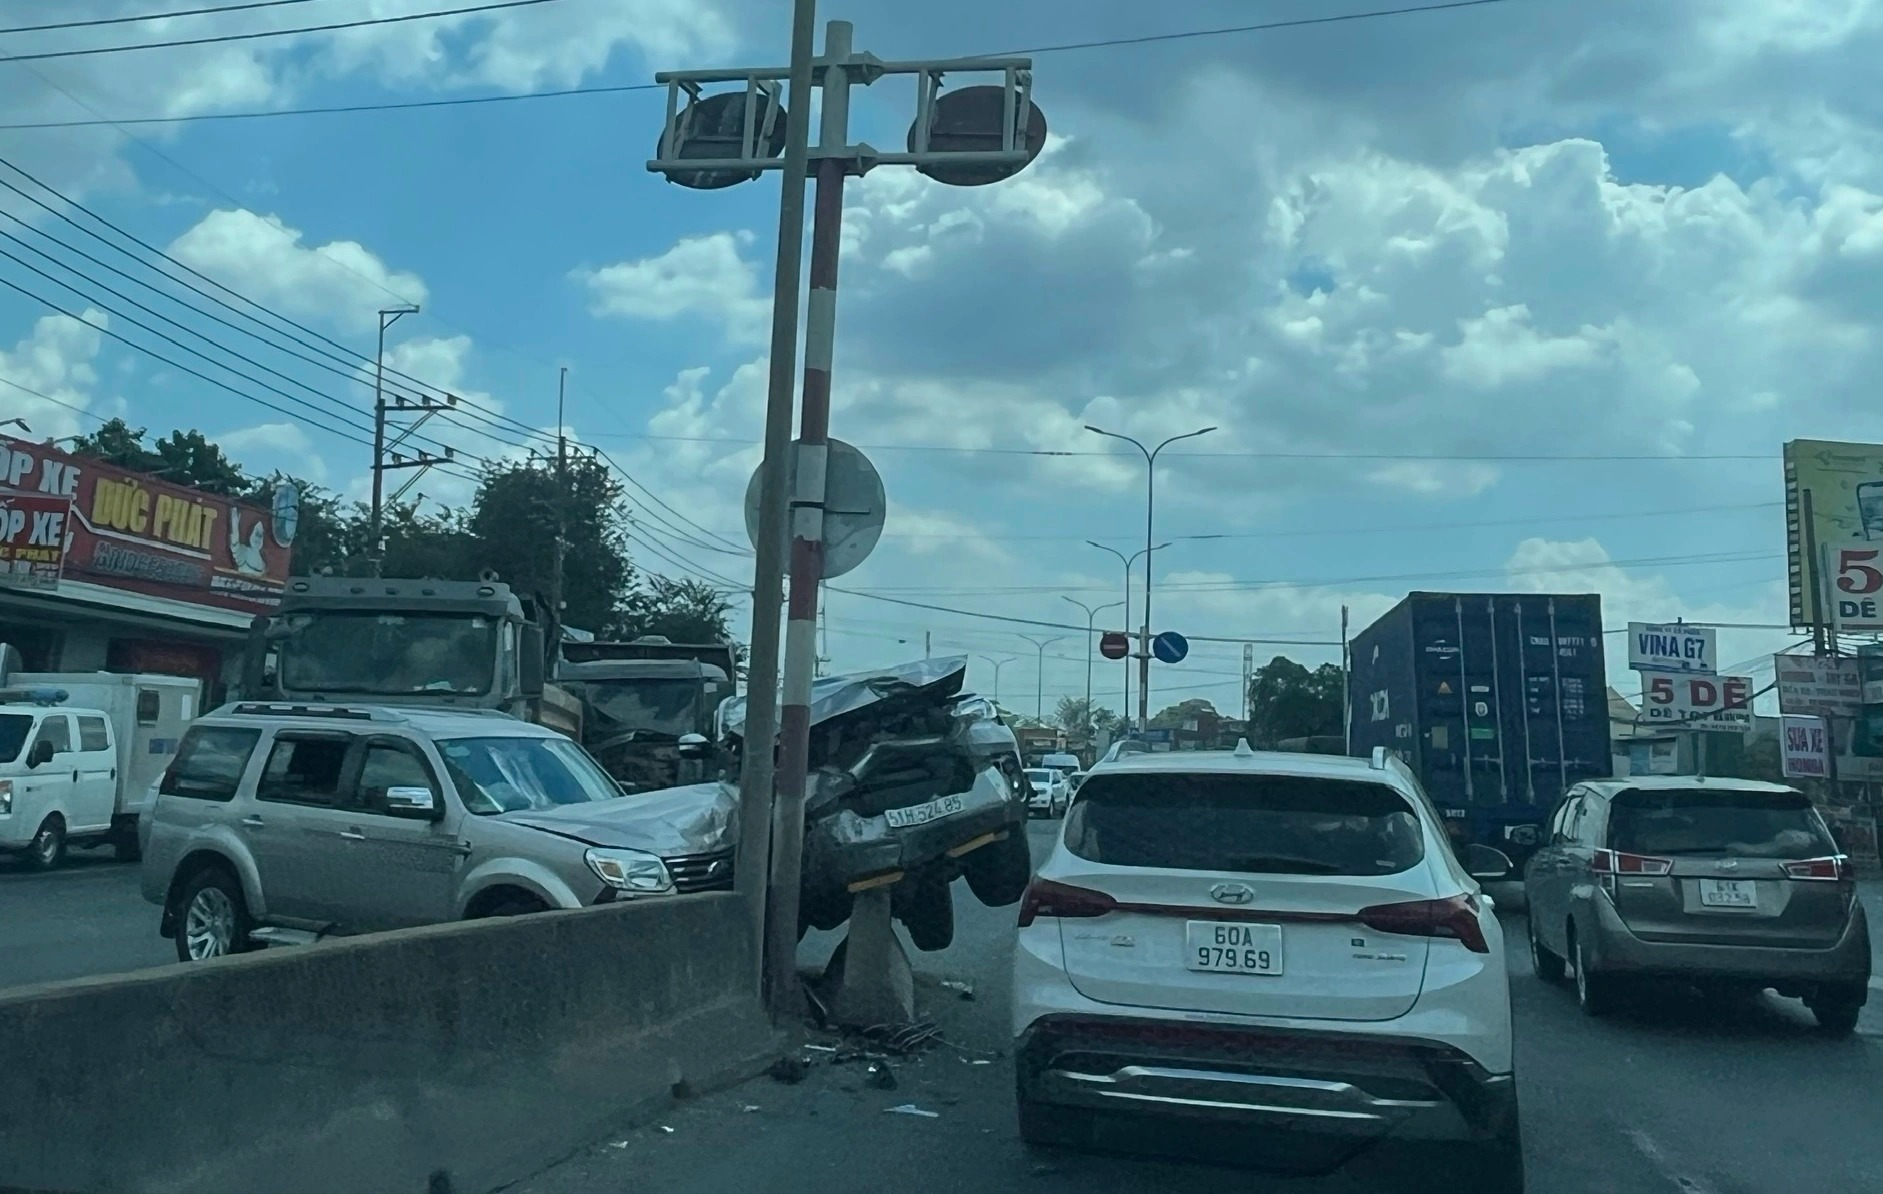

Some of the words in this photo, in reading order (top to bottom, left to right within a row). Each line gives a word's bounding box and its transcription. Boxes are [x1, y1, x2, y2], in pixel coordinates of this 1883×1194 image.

[39, 459, 81, 500] XE
[29, 511, 64, 547] XE
[1837, 550, 1883, 595] 5
[1639, 633, 1680, 658] VINA
[1684, 637, 1705, 659] G7
[1650, 678, 1674, 705] 5
[1689, 677, 1748, 710] DÊ
[1215, 926, 1253, 946] 60A
[1198, 947, 1270, 970] 979.69
